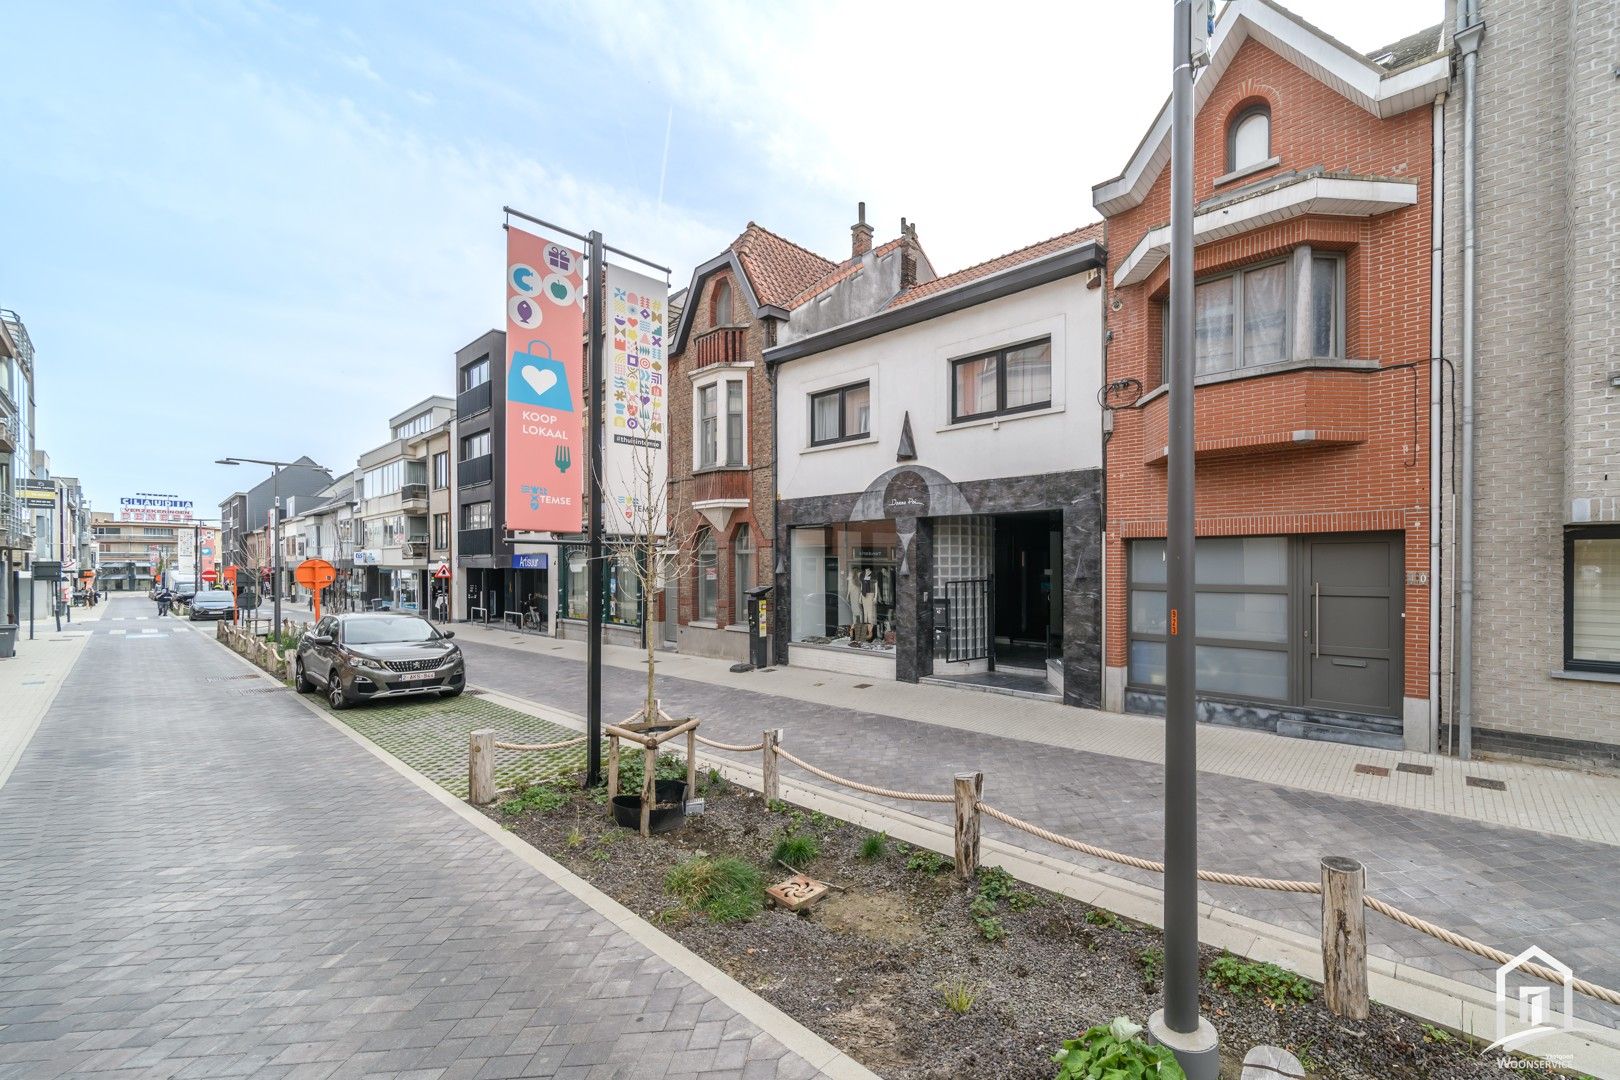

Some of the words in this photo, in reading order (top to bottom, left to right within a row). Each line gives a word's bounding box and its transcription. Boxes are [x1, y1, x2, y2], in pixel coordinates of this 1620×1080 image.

[522, 410, 558, 424] KOOP
[522, 424, 569, 440] LOKAAL
[122, 499, 193, 507] CLAUDIA
[539, 495, 571, 505] TEMSE
